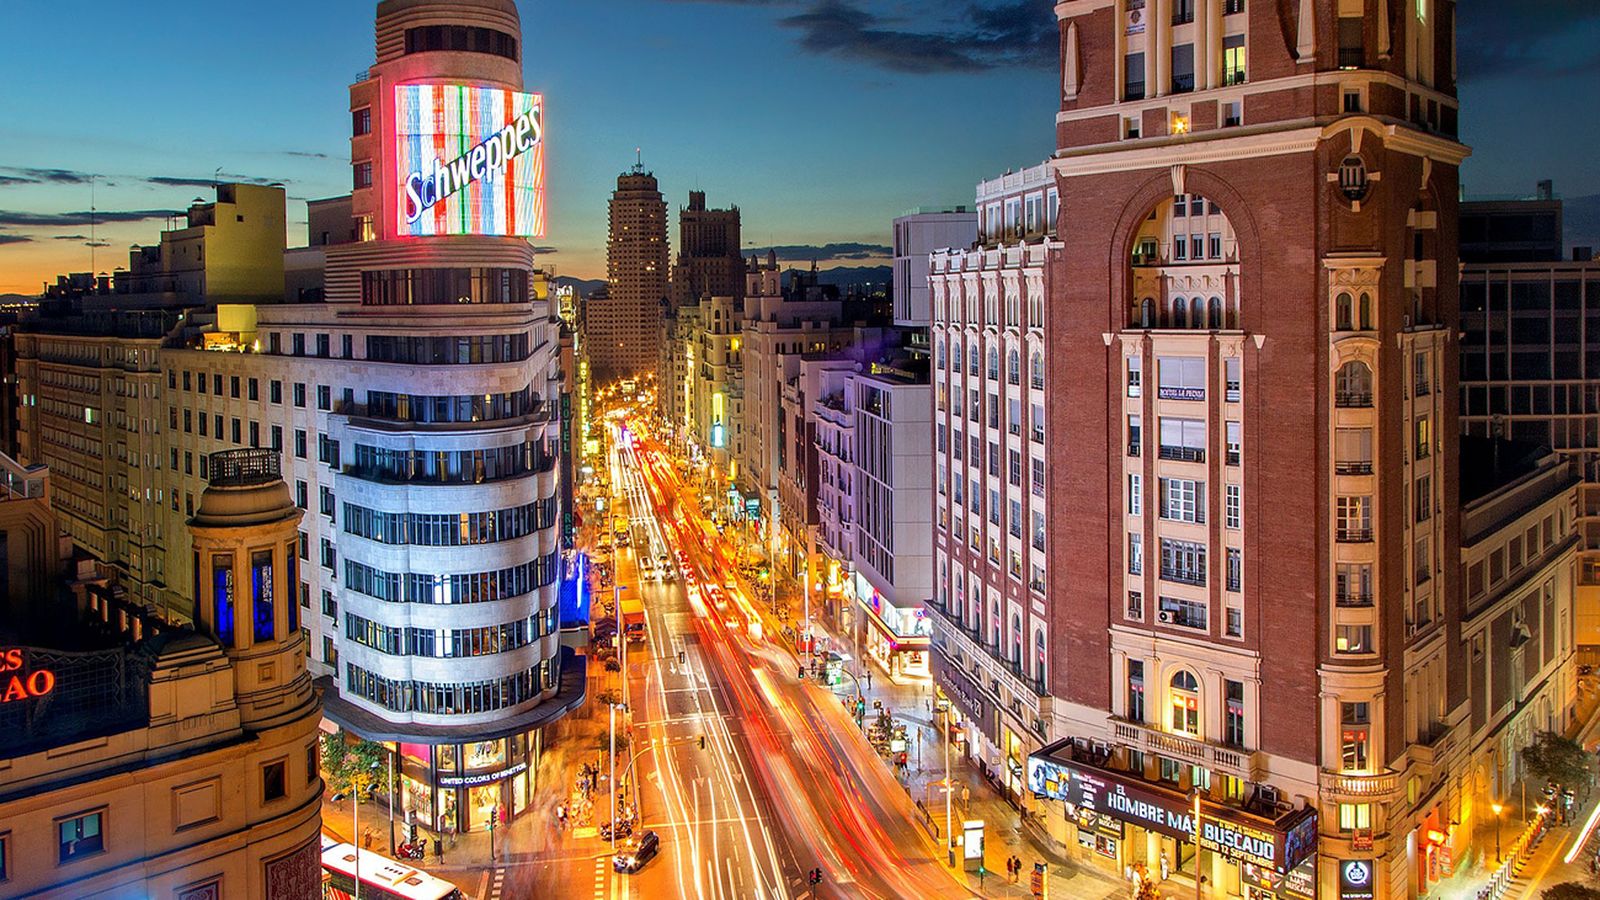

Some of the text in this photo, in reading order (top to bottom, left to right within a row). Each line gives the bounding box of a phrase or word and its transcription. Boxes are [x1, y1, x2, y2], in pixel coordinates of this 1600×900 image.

[405, 102, 542, 225] Schweppes
[562, 398, 572, 545] HOTEL REX
[0, 669, 55, 703] AO
[440, 777, 463, 785] UNITED
[464, 774, 491, 784] COLORS
[491, 772, 500, 780] OF
[1116, 783, 1126, 796] EL
[1107, 791, 1165, 825] HOMBRE
[1203, 822, 1276, 861] BUSCADO
[1220, 844, 1229, 855] 12
[1230, 847, 1275, 870] SEPTIEMBRE
[1285, 880, 1314, 896] BUSCADO
